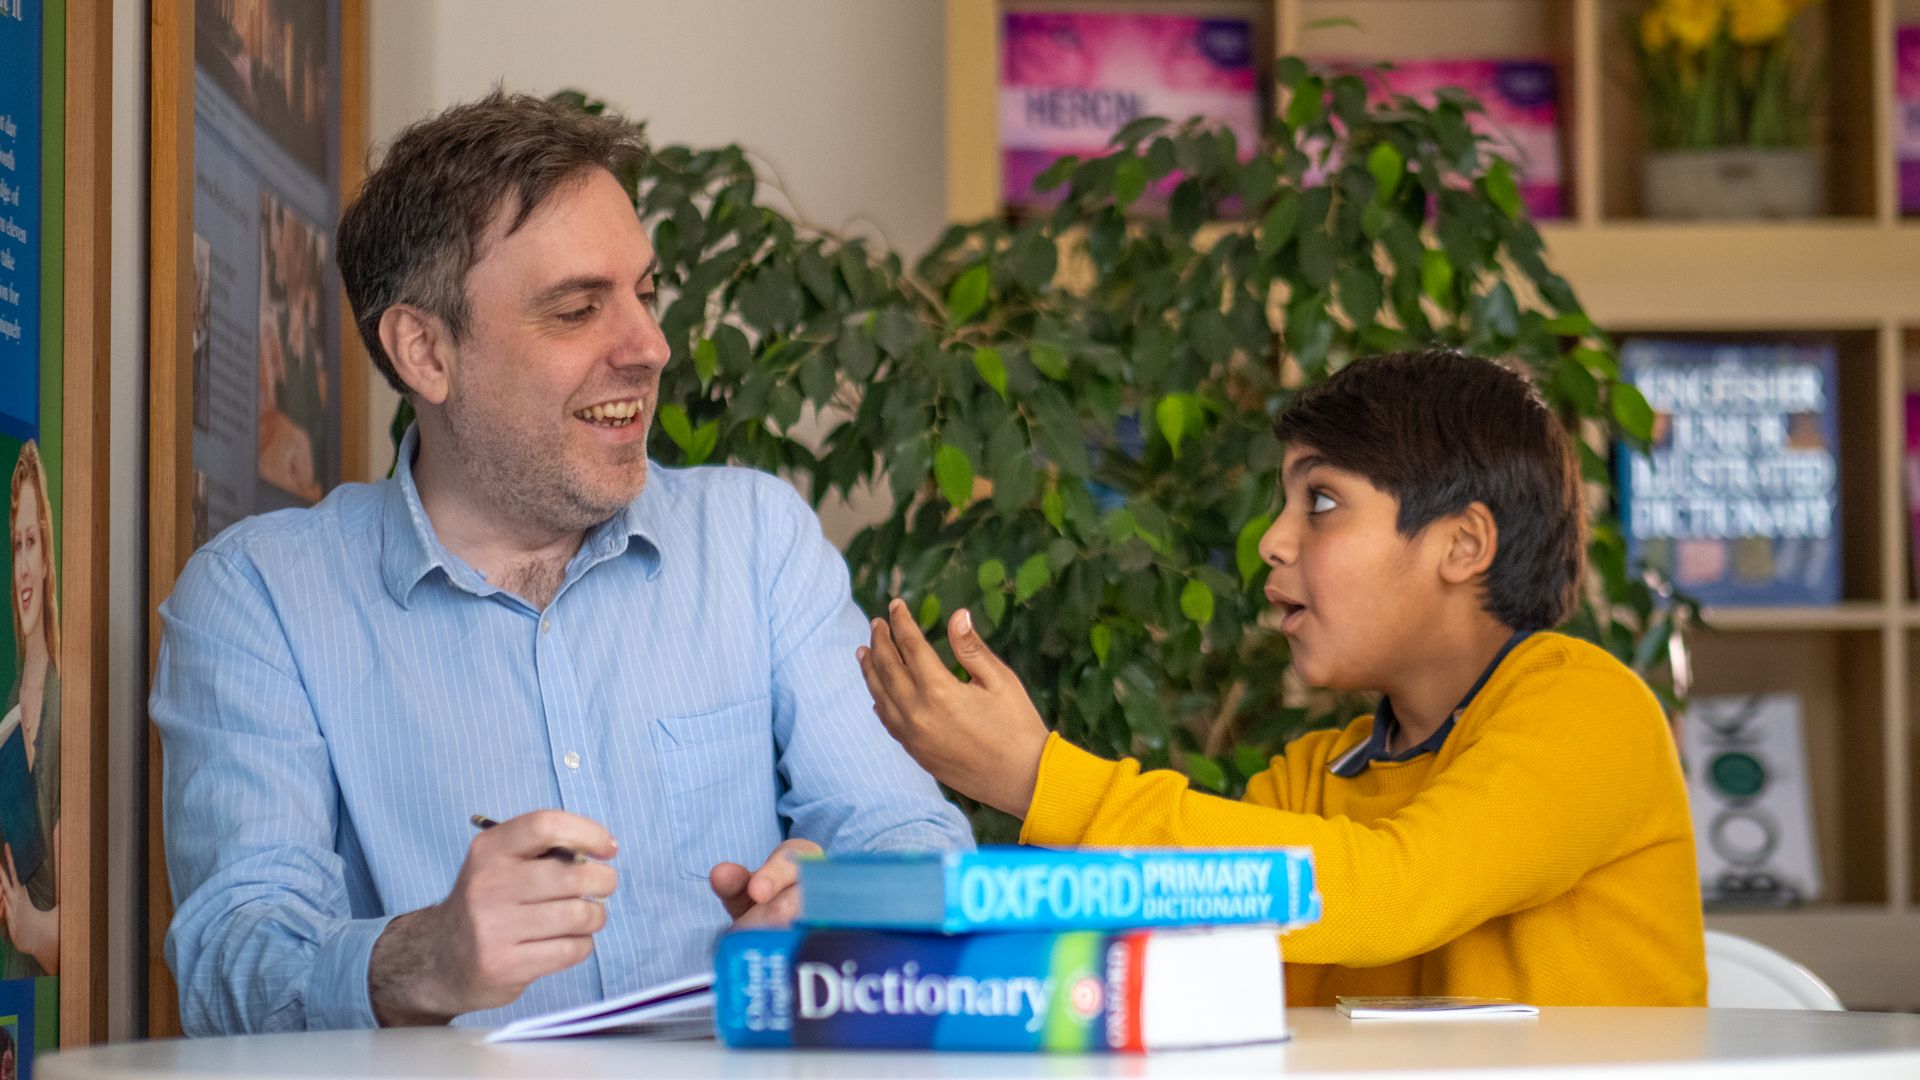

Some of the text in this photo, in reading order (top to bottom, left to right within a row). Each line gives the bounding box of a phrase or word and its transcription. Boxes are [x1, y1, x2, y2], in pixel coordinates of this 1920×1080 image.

[1023, 87, 1140, 130] HERON
[1671, 411, 1790, 452] JUNIOR
[1630, 450, 1837, 501] ILLUSTRATED
[1630, 498, 1836, 541] DICTIONARY
[960, 866, 1140, 922] OXFORD
[1142, 859, 1274, 896] PRIMARY
[1142, 894, 1274, 920] DICTIONARY
[797, 959, 1049, 1034] Dictionary
[1105, 940, 1131, 1049] OXFORD
